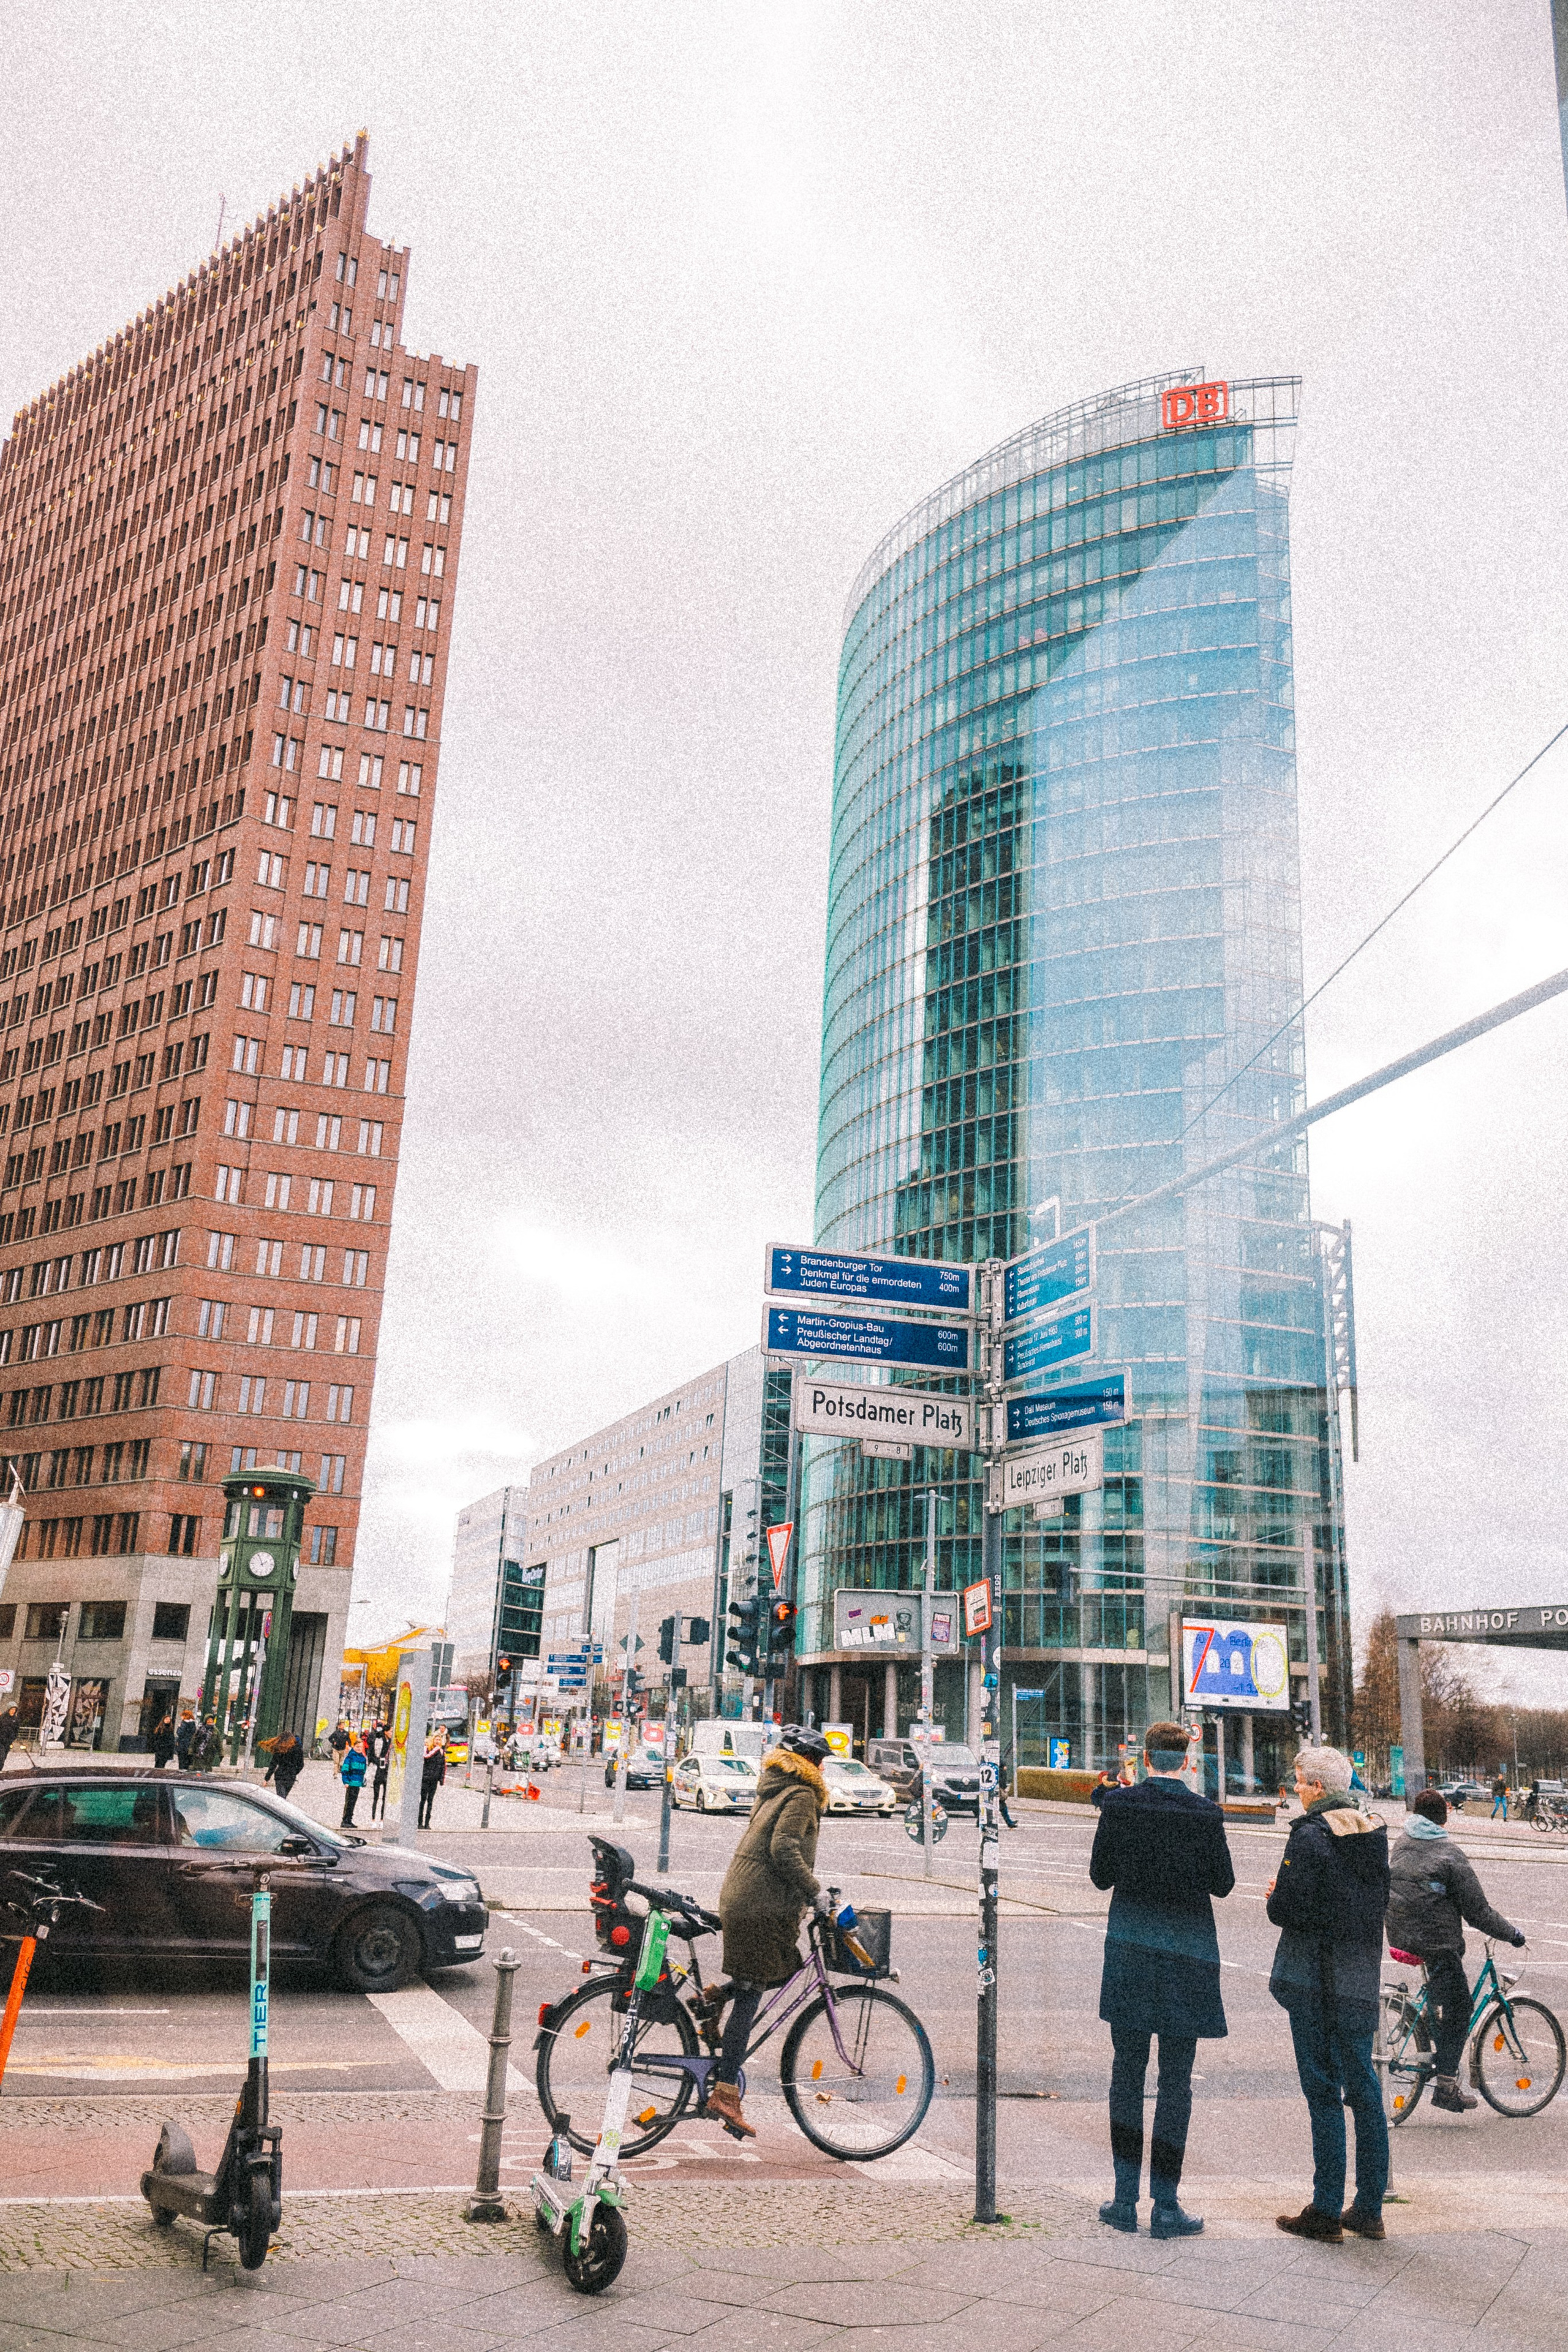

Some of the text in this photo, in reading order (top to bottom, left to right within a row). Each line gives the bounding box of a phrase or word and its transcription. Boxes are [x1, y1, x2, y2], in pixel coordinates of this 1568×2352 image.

[1170, 388, 1219, 421] DB
[800, 1267, 959, 1293] Denkmal für die ermordeten 400m
[801, 1256, 959, 1281] Brandenburger Tor 750m
[800, 1278, 867, 1293] Juden Europas
[797, 1315, 958, 1340] Martin-Gropius-Bau 600m
[797, 1327, 958, 1352] Preußischer Landtag/ 600m
[797, 1338, 881, 1354] Abgeordnetenhaus
[1035, 1401, 1056, 1412] Museum
[1102, 1387, 1112, 1398] 150
[813, 1390, 962, 1438] Potsdamer Platz
[1025, 1415, 1050, 1427] Deutsches
[1051, 1406, 1095, 1422] Spionagemuseum
[1102, 1401, 1112, 1411] 150
[896, 1446, 901, 1455] 8
[1011, 1450, 1087, 1491] Leipziger Platz
[1420, 1612, 1518, 1633] BAHNHOF
[840, 1623, 896, 1648] MLM
[980, 1769, 992, 1783] 12
[254, 1984, 267, 2051] TIER
